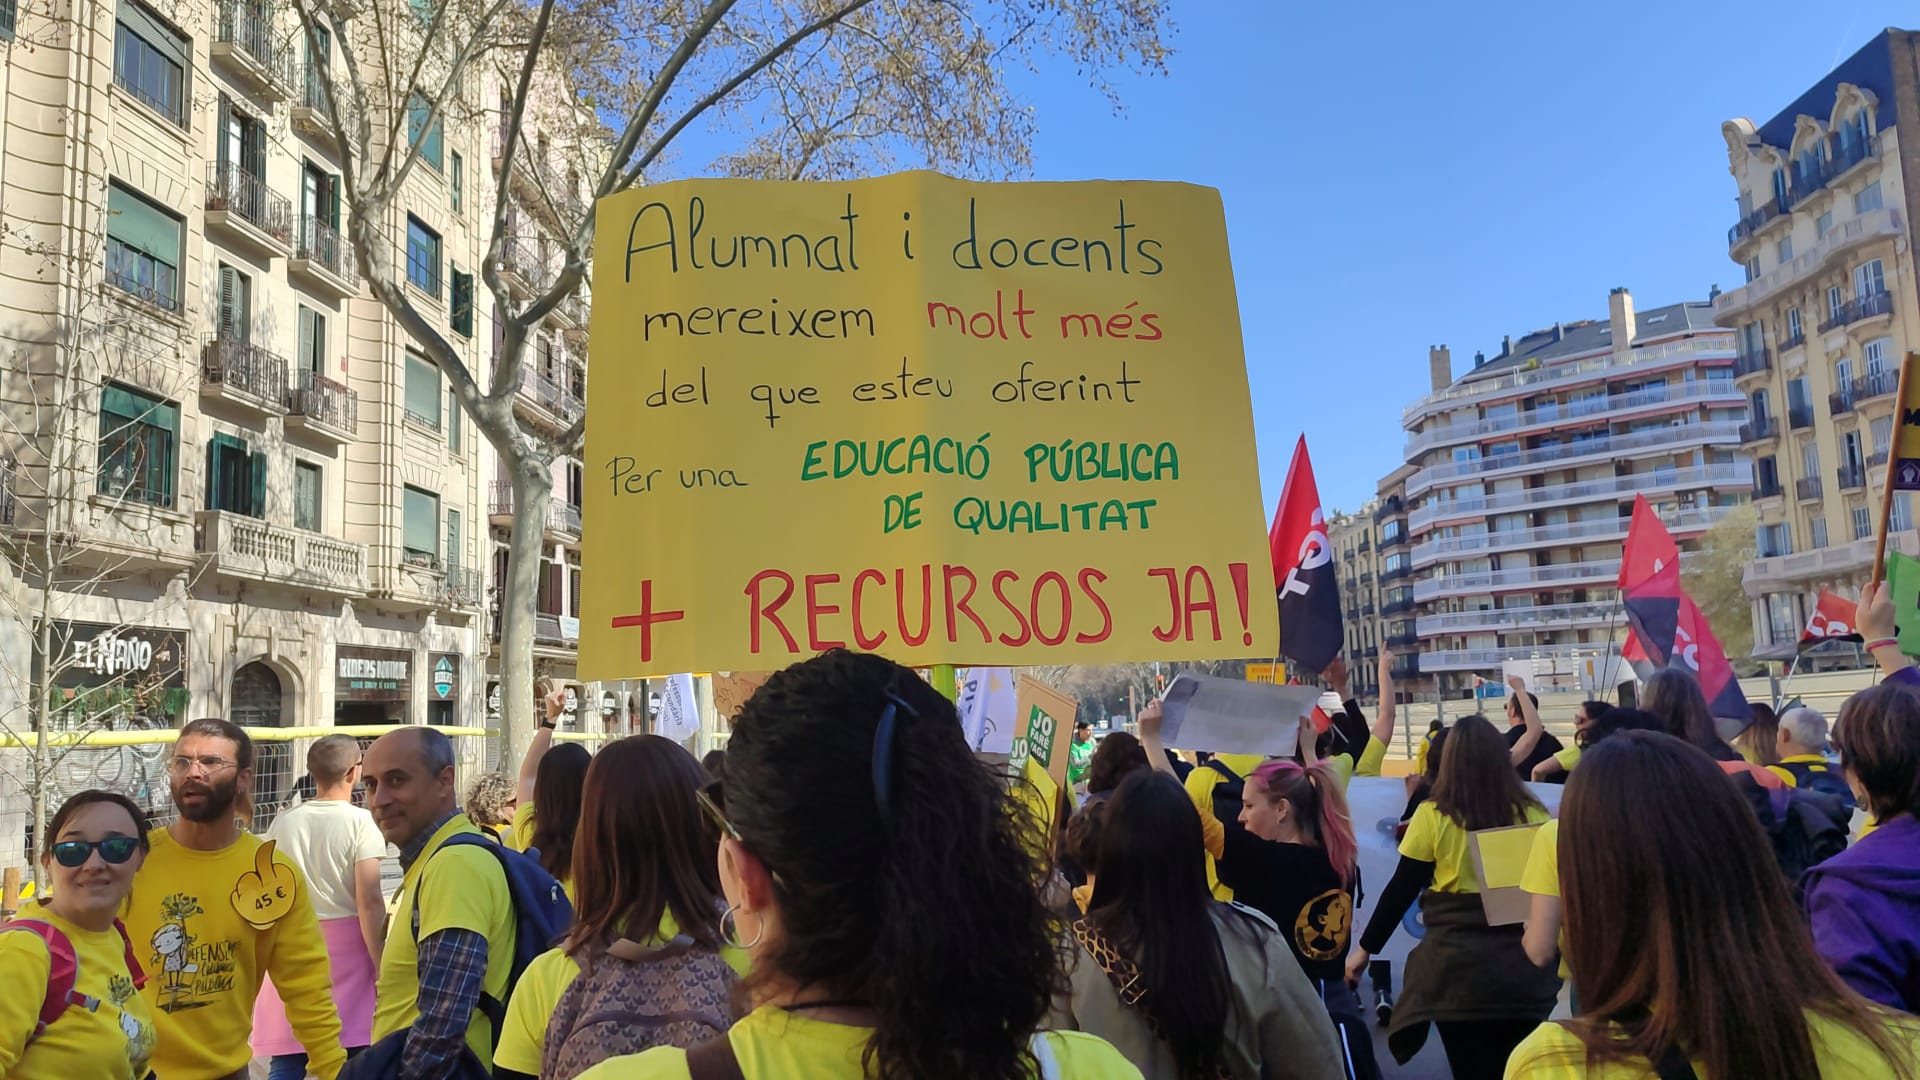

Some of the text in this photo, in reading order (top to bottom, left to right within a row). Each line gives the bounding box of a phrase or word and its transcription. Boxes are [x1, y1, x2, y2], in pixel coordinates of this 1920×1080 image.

[625, 194, 1164, 283] Alumnat i docents
[644, 288, 1163, 342] mereixem molt més
[645, 356, 1142, 429] del que esteu oferint
[605, 432, 1180, 497] Per una EDUCACIÓ PÚBLICA
[882, 490, 1158, 536] DE QUALITAT
[743, 563, 1114, 655] RECURSOS
[1146, 562, 1254, 647] JA!
[1011, 738, 1029, 759] JO
[1032, 711, 1054, 737] JO
[255, 885, 288, 911] 45 €
